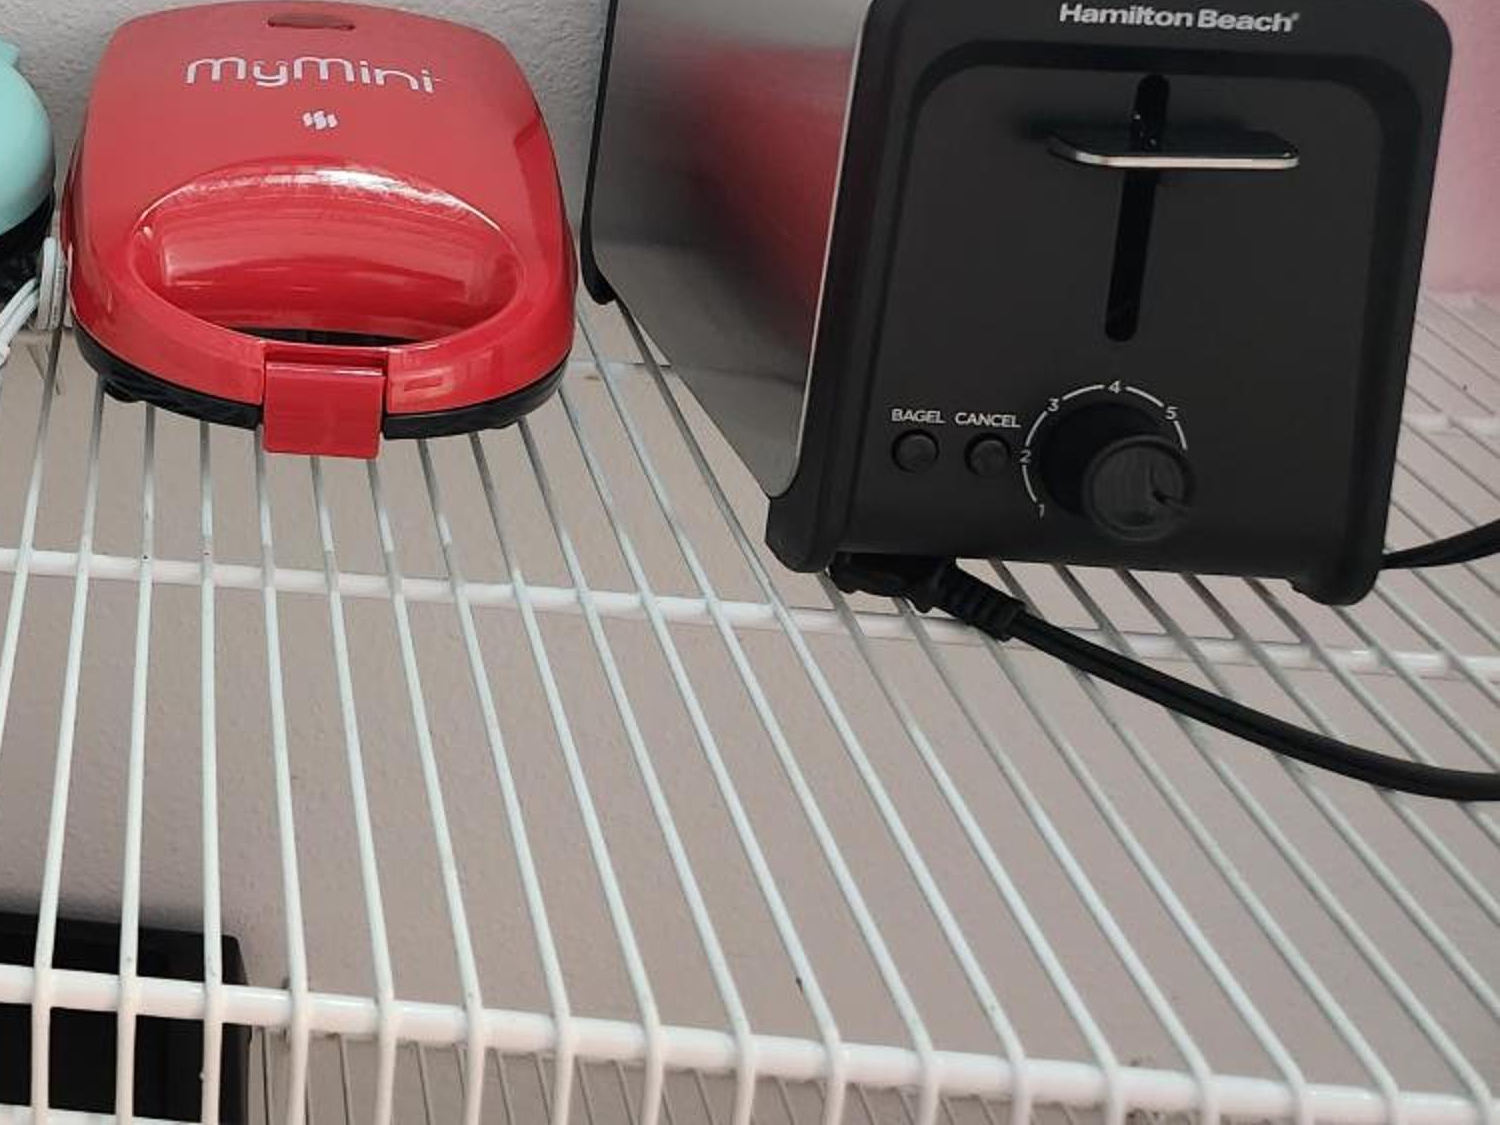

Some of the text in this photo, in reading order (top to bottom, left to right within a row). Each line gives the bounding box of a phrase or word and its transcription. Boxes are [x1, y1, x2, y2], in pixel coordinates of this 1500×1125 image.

[1058, 2, 1293, 32] Hamilton Beach
[1108, 380, 1122, 394] 4
[1048, 398, 1060, 412] 3
[891, 408, 946, 424] BAGEL
[954, 411, 1021, 428] CANCEL
[1165, 406, 1178, 420] 5
[1020, 449, 1032, 463] 2
[1038, 503, 1046, 519] 1
